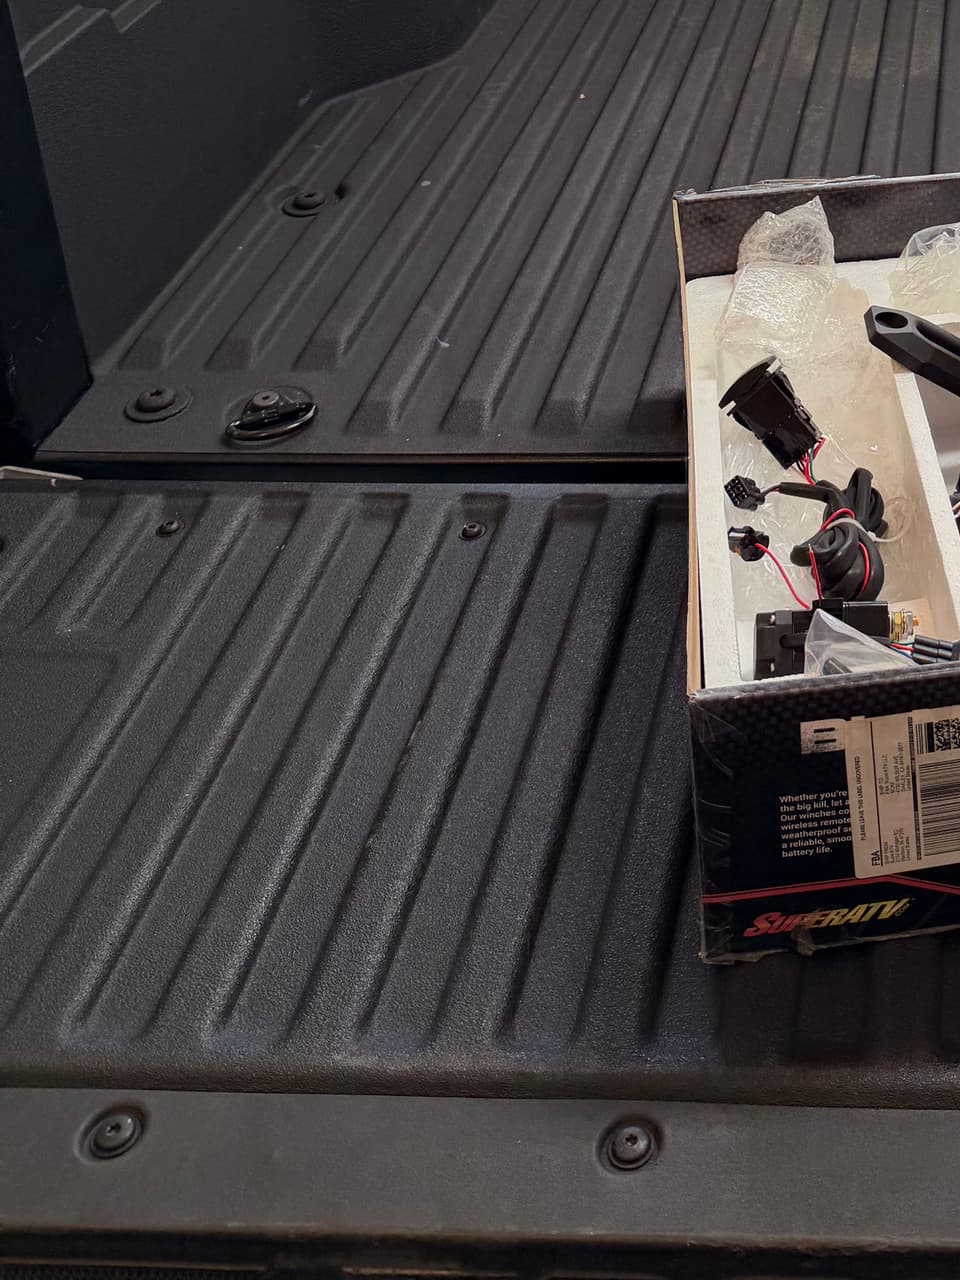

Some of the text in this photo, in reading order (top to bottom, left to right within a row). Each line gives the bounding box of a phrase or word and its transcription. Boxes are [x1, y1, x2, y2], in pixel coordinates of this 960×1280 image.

[779, 790, 847, 803] Whether you're
[797, 803, 811, 811] big
[814, 801, 829, 809] kill,
[831, 799, 844, 807] let
[799, 810, 836, 819] winches
[781, 822, 817, 830] wireless
[781, 826, 841, 839] weatherproof
[790, 839, 825, 847] reliable,
[782, 846, 832, 858] battery life.
[871, 851, 880, 866] FBA
[743, 898, 910, 937] SUPERATV
